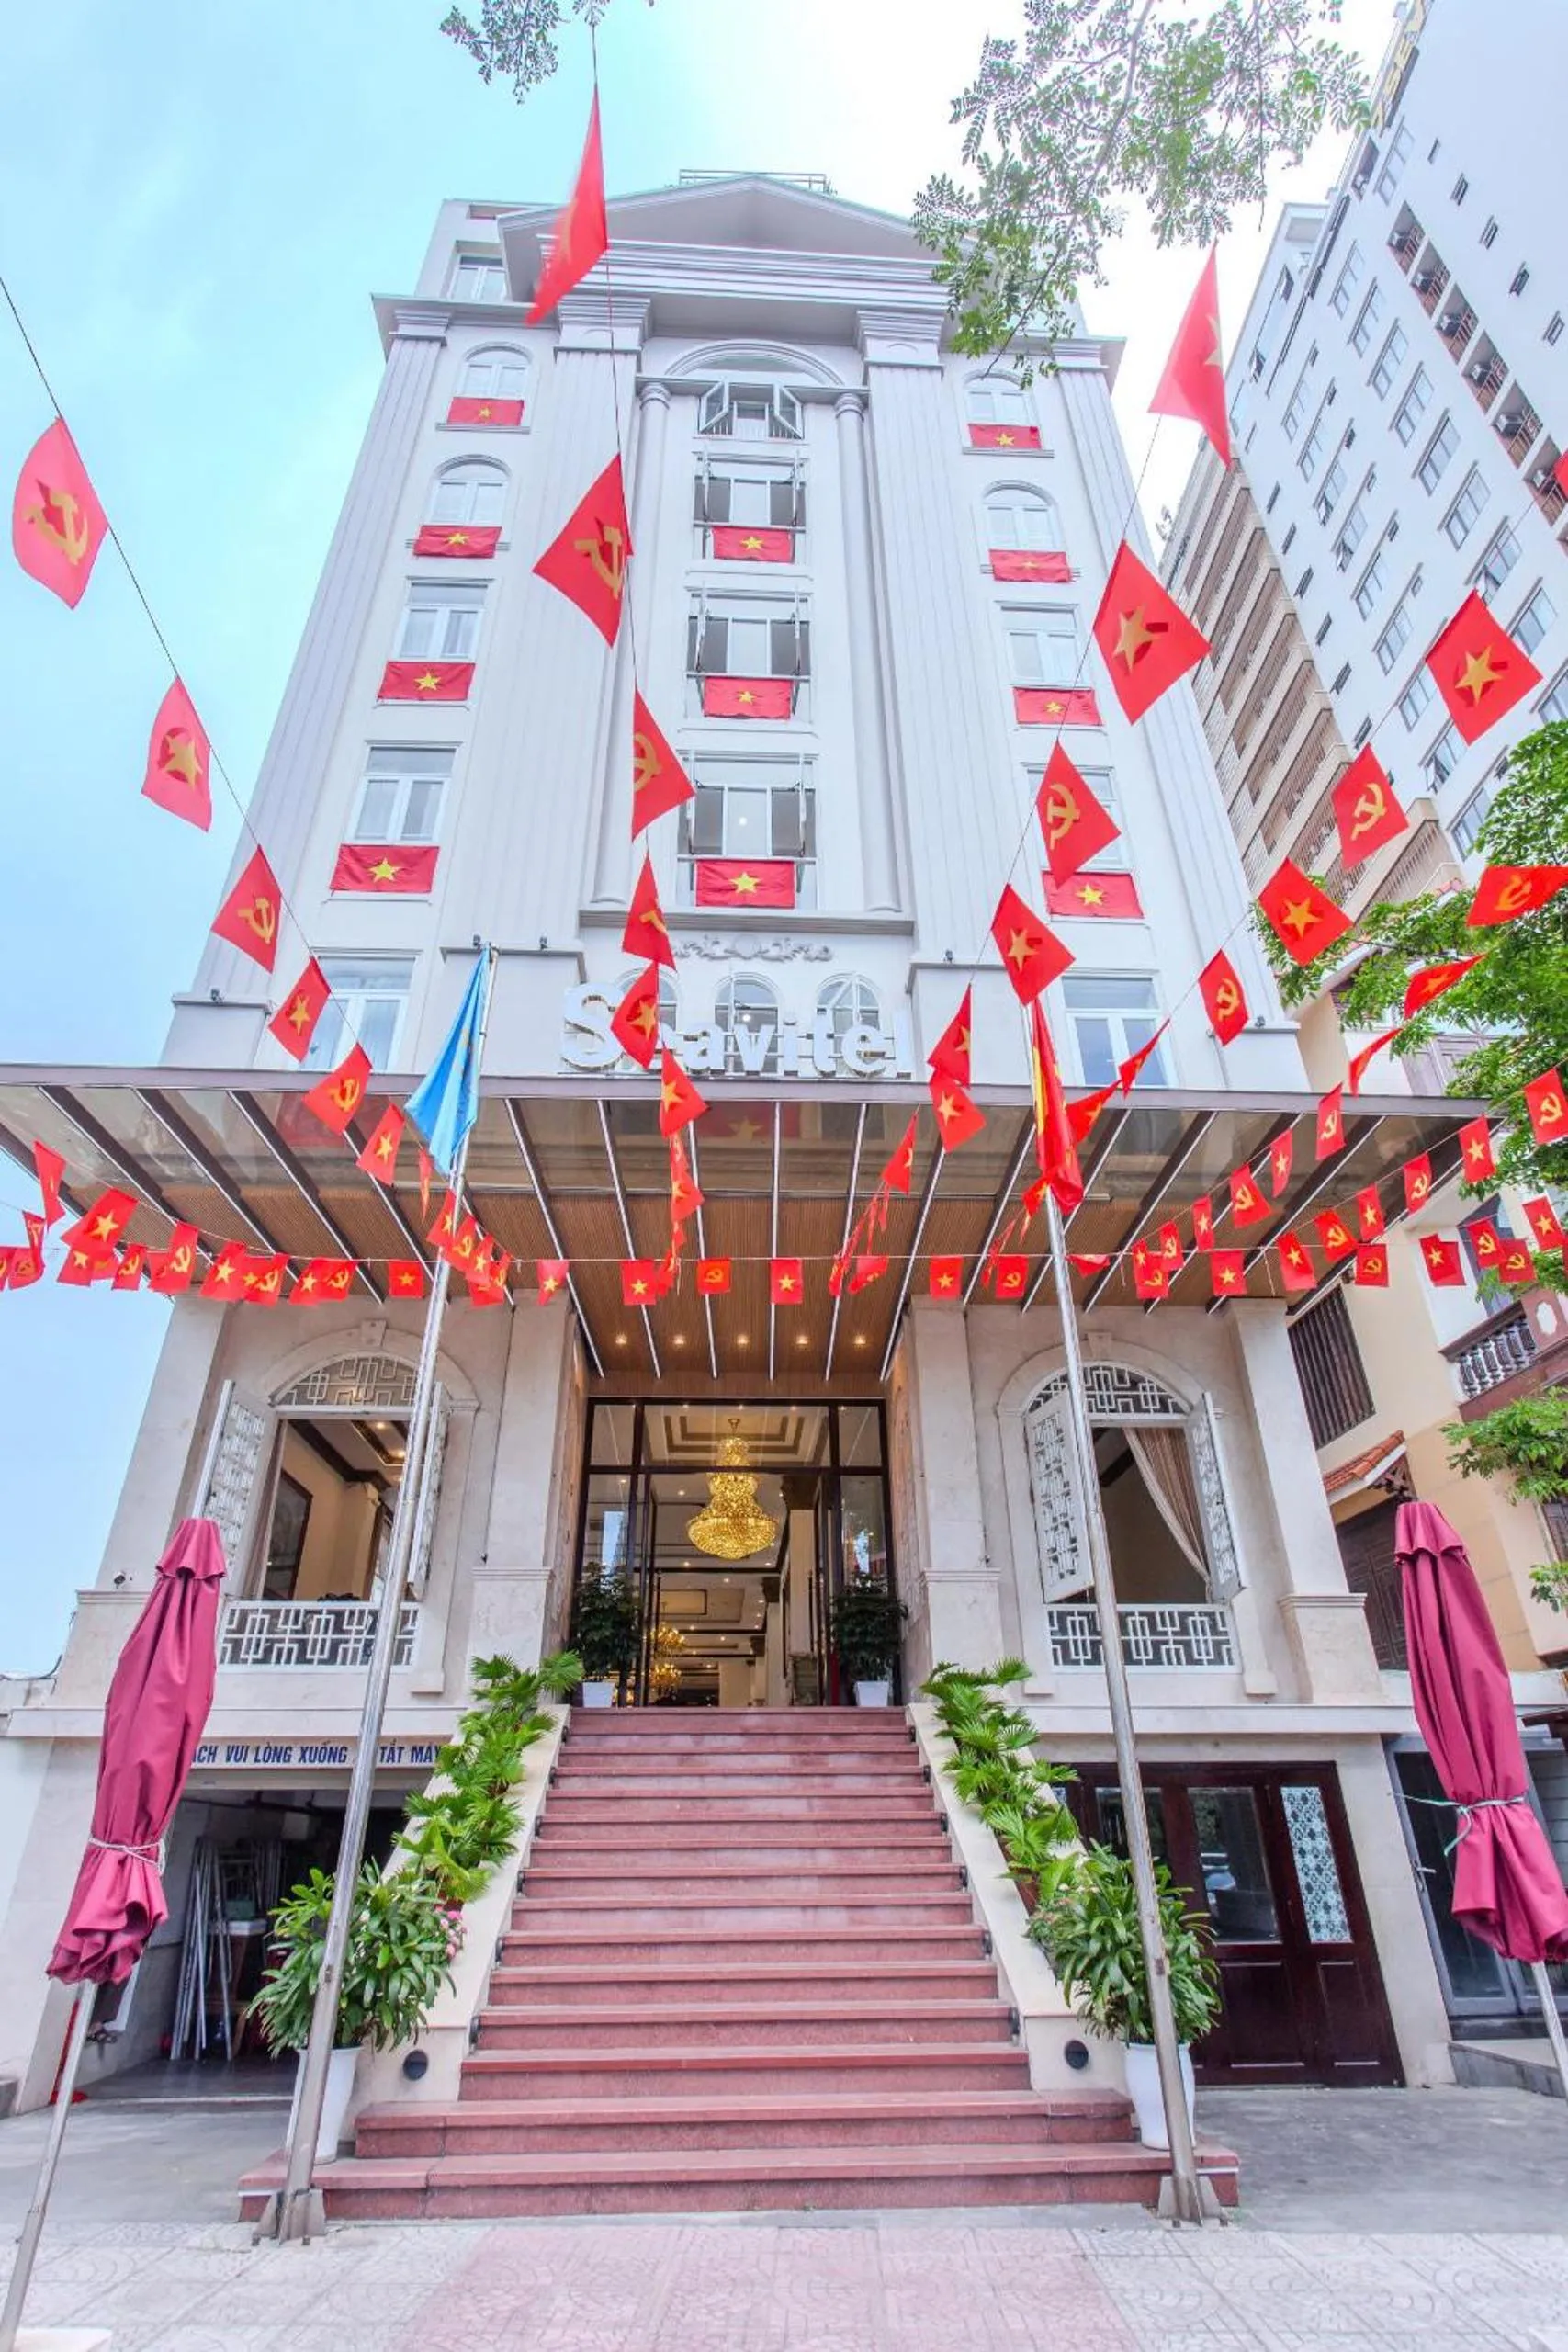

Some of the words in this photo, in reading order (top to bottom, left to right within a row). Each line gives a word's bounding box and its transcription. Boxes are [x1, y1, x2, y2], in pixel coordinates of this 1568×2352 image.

[225, 1745, 250, 1763] VUI
[254, 1741, 293, 1763] LÒNG
[298, 1740, 348, 1763] XUỐNG
